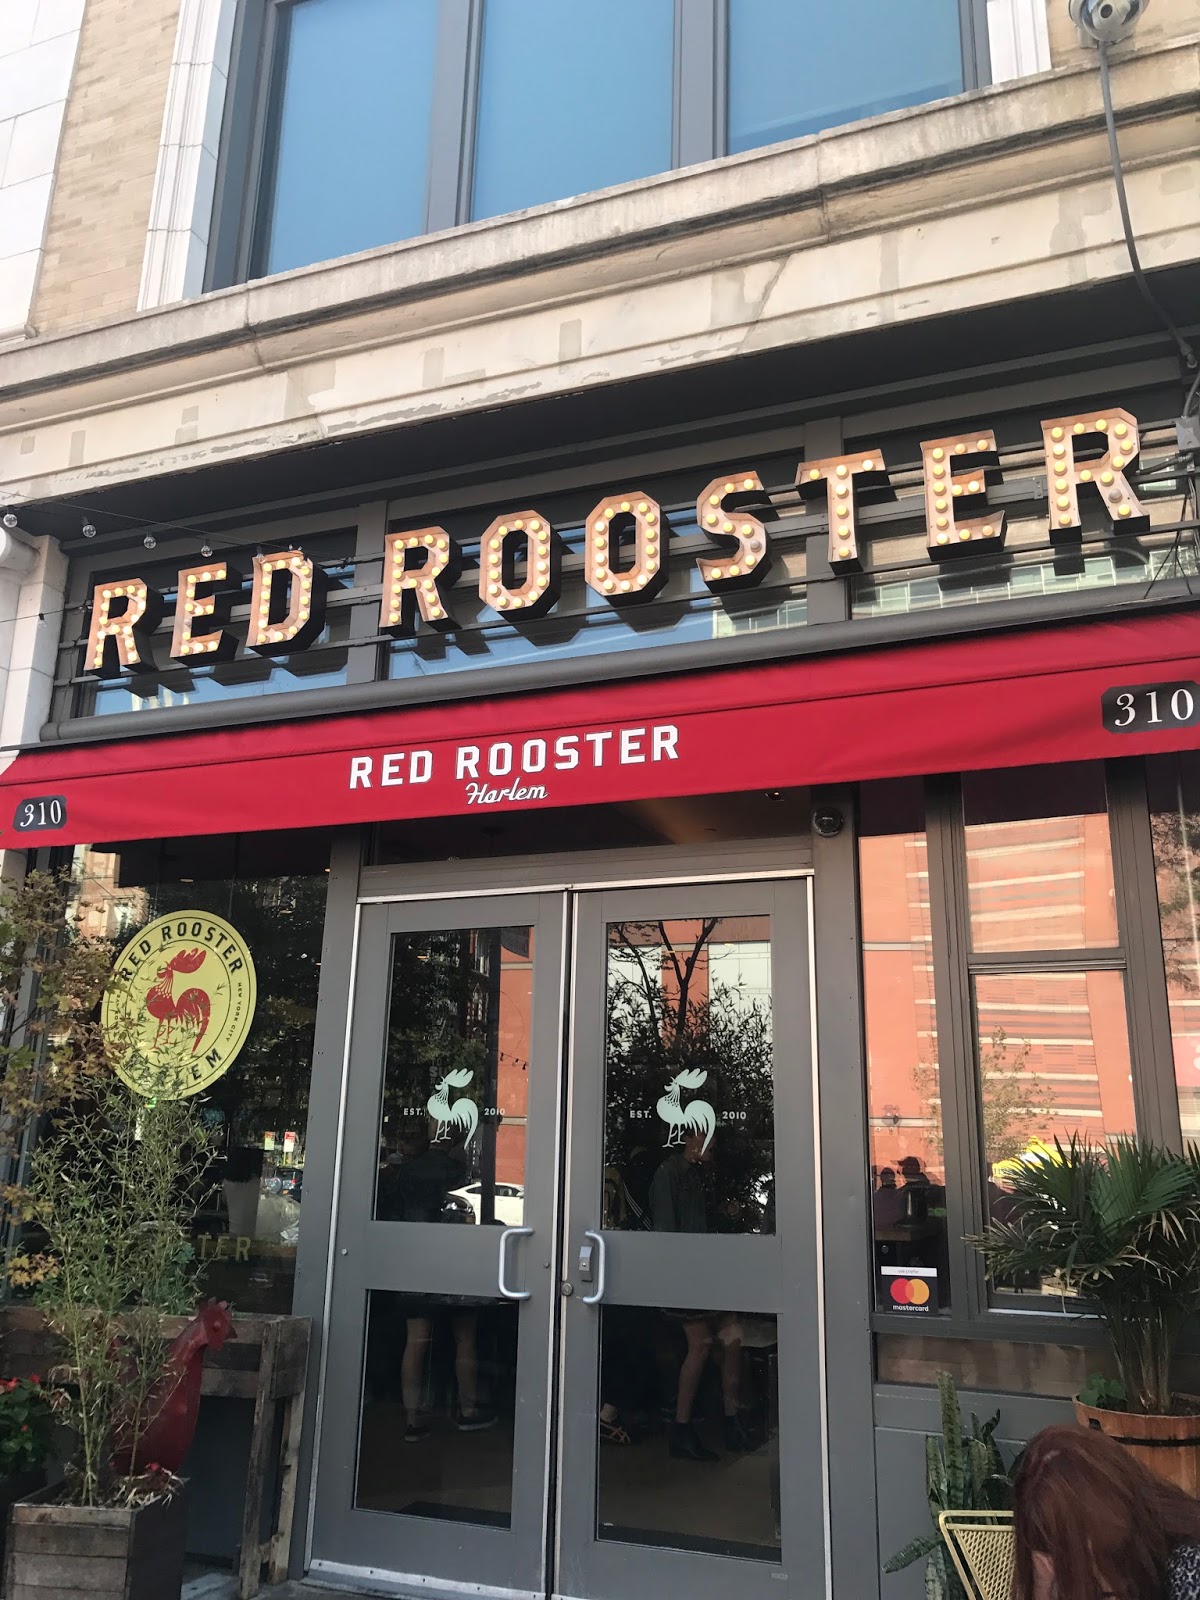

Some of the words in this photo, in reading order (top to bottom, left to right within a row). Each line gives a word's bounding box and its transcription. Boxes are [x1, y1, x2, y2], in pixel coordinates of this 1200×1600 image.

[84, 550, 318, 674] RED
[379, 407, 1150, 630] ROOSTER
[1114, 688, 1194, 727] 310
[349, 750, 433, 790] RED
[456, 724, 679, 780] ROOSTER
[465, 777, 549, 806] Harlem
[20, 799, 62, 828] 310
[121, 939, 153, 982] RED
[161, 921, 243, 976] ROOSTER
[234, 1000, 242, 1022] YORK
[225, 1024, 236, 1042] CITY
[403, 1108, 423, 1116] EST.
[484, 1108, 506, 1116] 2010
[630, 1110, 652, 1119] EST.
[722, 1111, 747, 1120] 2010
[892, 1304, 929, 1312] mastercard
